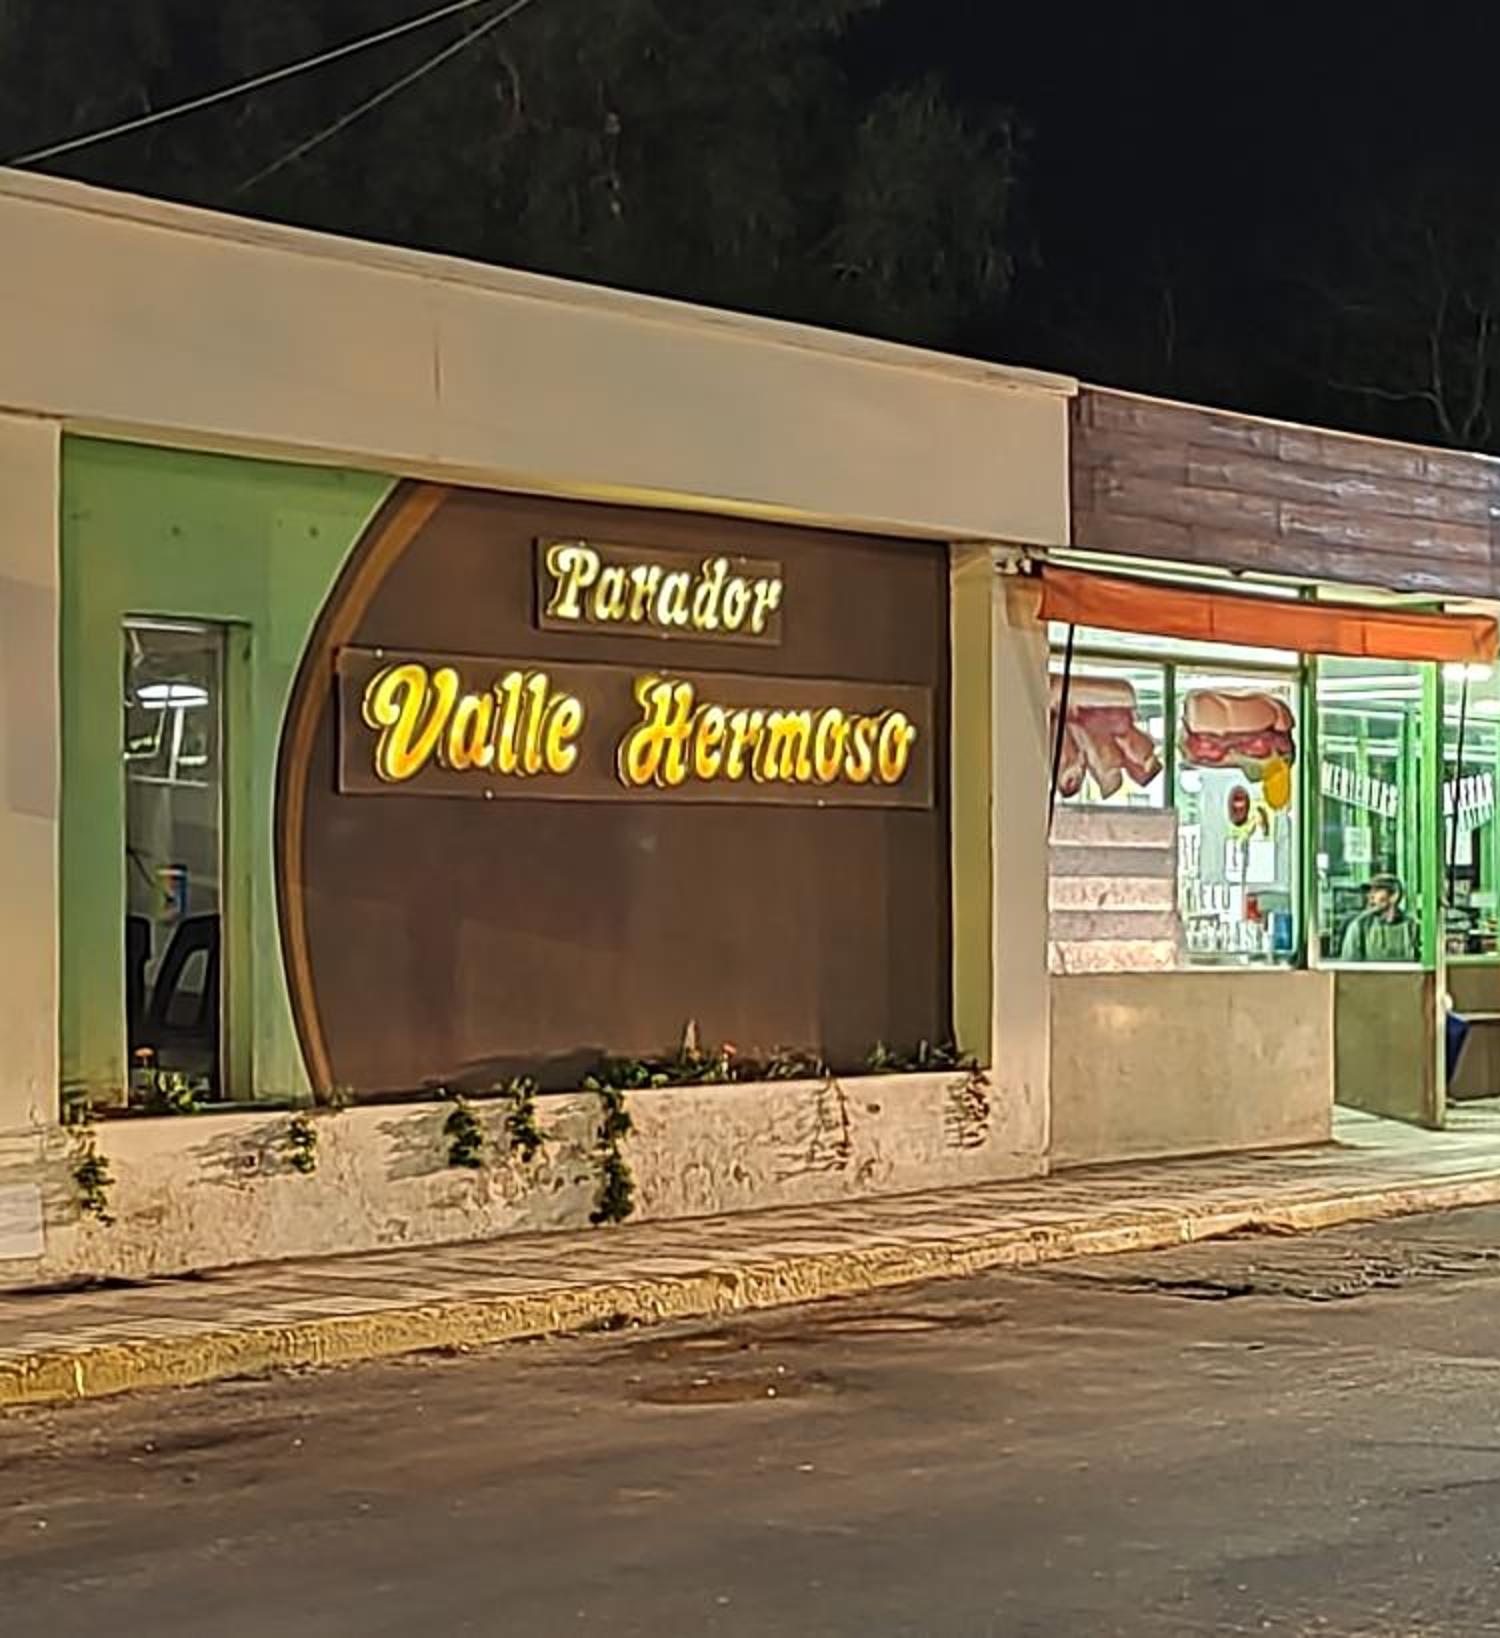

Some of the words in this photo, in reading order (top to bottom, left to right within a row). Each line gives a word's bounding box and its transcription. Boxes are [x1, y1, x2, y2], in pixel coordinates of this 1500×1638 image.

[547, 543, 782, 634] Parador
[362, 664, 584, 782] Valle
[618, 672, 916, 788] Hermoso
